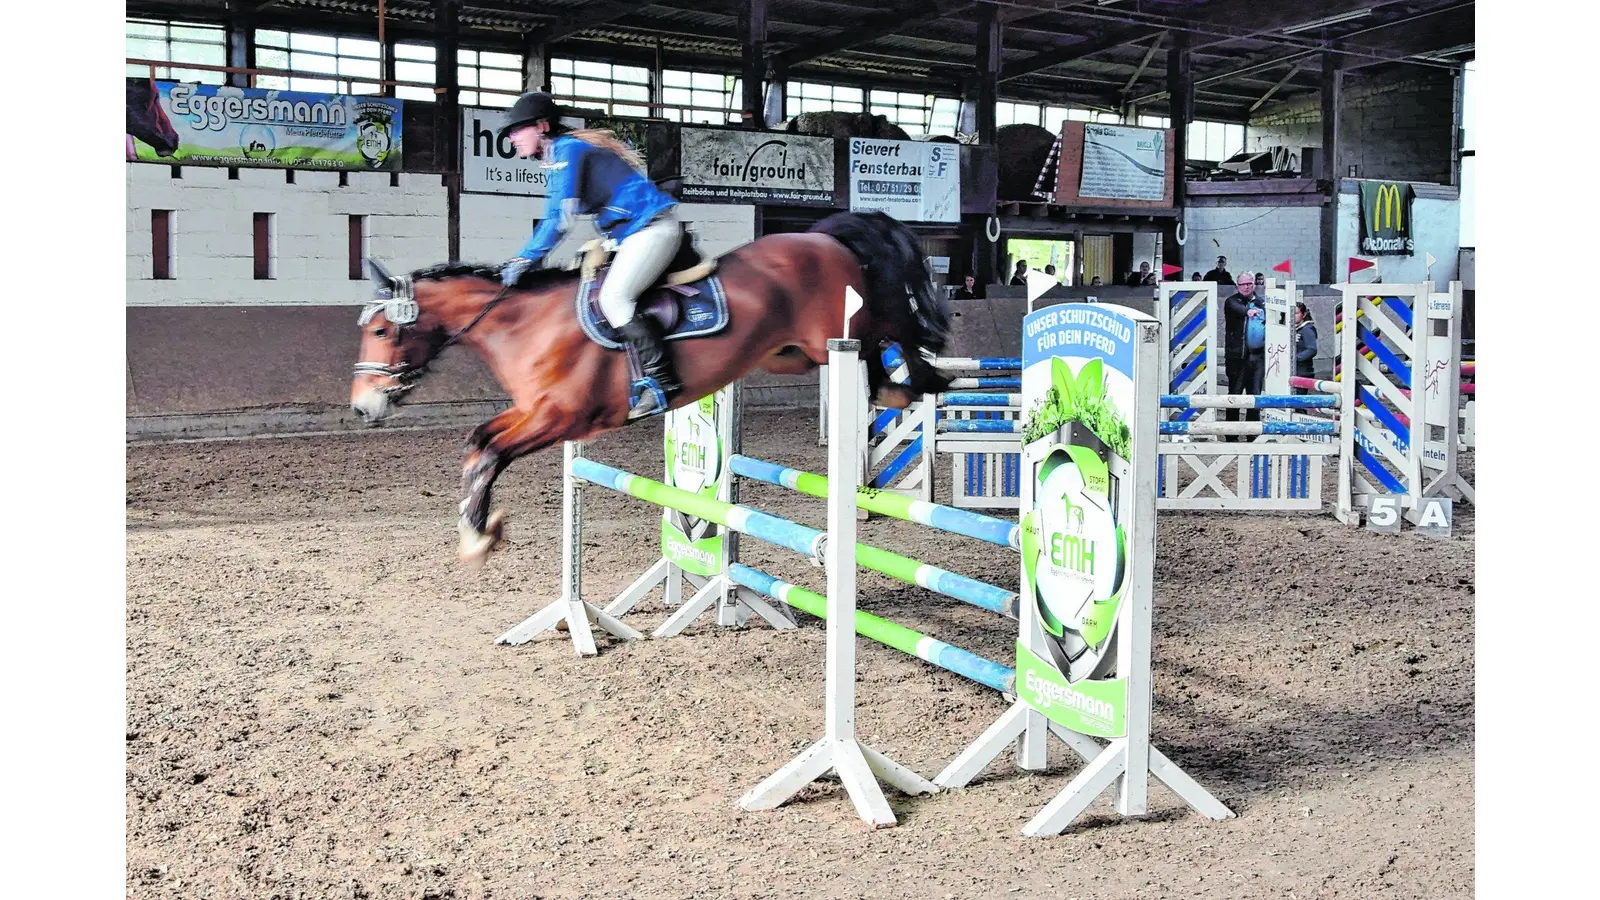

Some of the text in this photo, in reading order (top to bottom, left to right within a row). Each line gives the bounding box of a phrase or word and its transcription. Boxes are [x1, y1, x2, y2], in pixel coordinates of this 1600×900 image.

[169, 86, 347, 131] Eggersmann
[473, 119, 527, 159] ho
[852, 141, 900, 156] Sievert
[931, 147, 942, 162] S
[505, 171, 512, 182] a
[515, 168, 550, 187] lifesty
[851, 160, 922, 176] Fensterbau
[937, 162, 947, 177] F
[683, 187, 715, 196] Reitböden
[716, 188, 728, 197] und
[729, 189, 768, 199] Reitplatzbau
[772, 192, 832, 201] www.fair-ground.de
[1027, 309, 1131, 344] UNSER SCHUTZSCHILD
[1037, 329, 1116, 356] FÜR DEIN PFERD
[681, 442, 706, 469] EMH
[1423, 448, 1446, 461] inteln
[1369, 498, 1449, 527] 5 A
[1026, 526, 1040, 535] HAUT
[1051, 532, 1095, 575] EMH
[1082, 617, 1098, 628] DARM
[1025, 669, 1115, 722] Eggersmann
